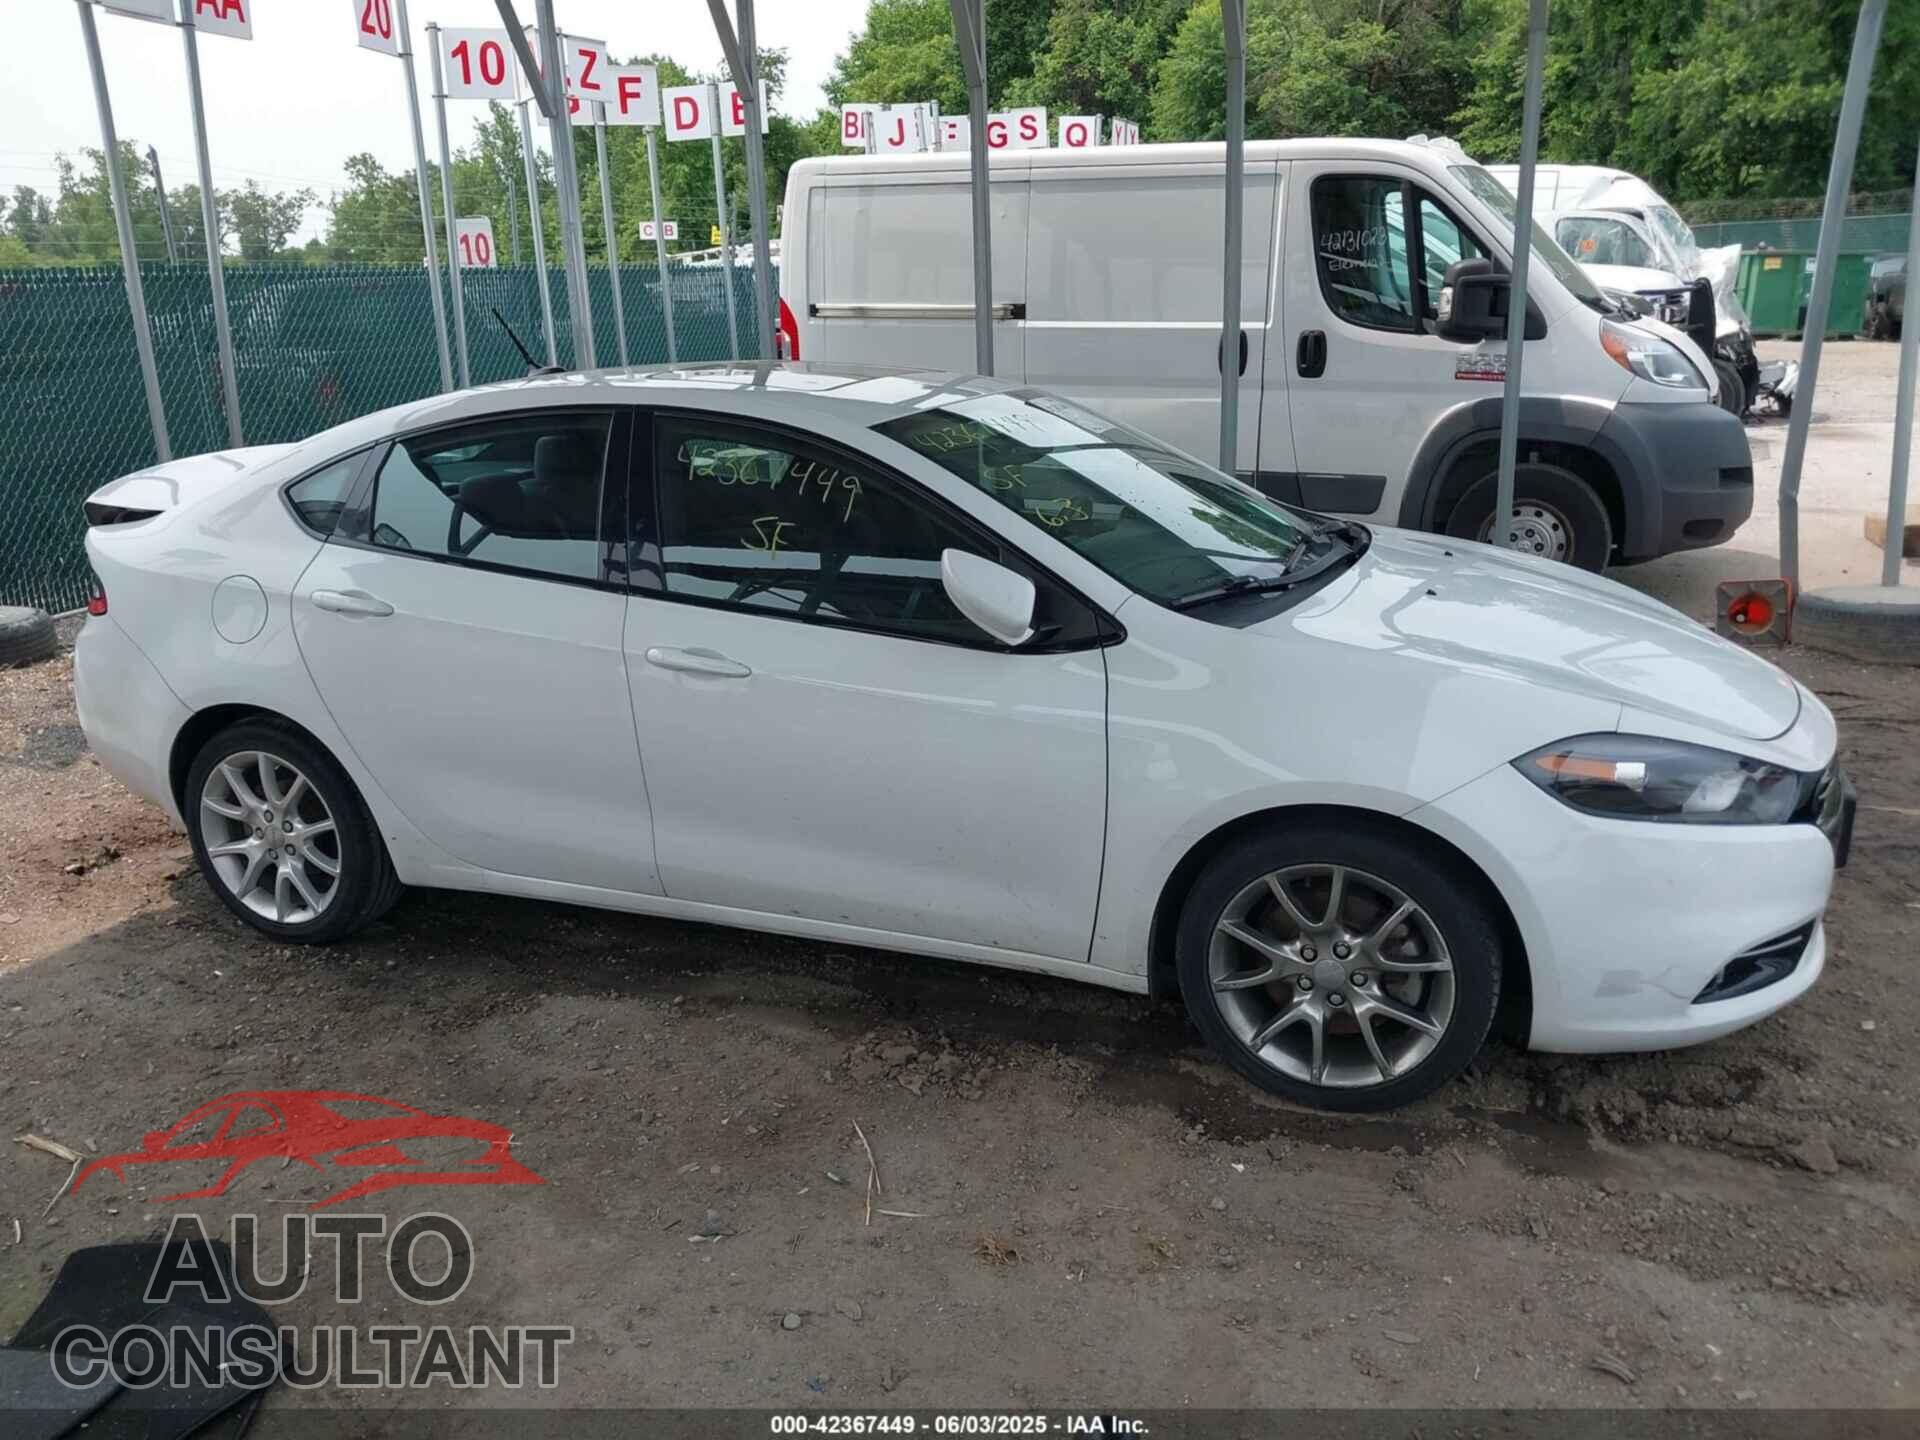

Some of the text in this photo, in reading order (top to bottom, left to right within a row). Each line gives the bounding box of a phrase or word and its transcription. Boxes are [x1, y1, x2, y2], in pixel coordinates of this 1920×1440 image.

[360, 0, 392, 40] 20
[450, 40, 505, 86] 10
[578, 48, 602, 91] Z
[617, 76, 642, 115] F
[673, 96, 699, 130] D
[1019, 114, 1038, 141] S
[888, 118, 905, 147] J
[986, 121, 1008, 149] G
[1065, 122, 1088, 148] Q
[459, 232, 490, 266] 10
